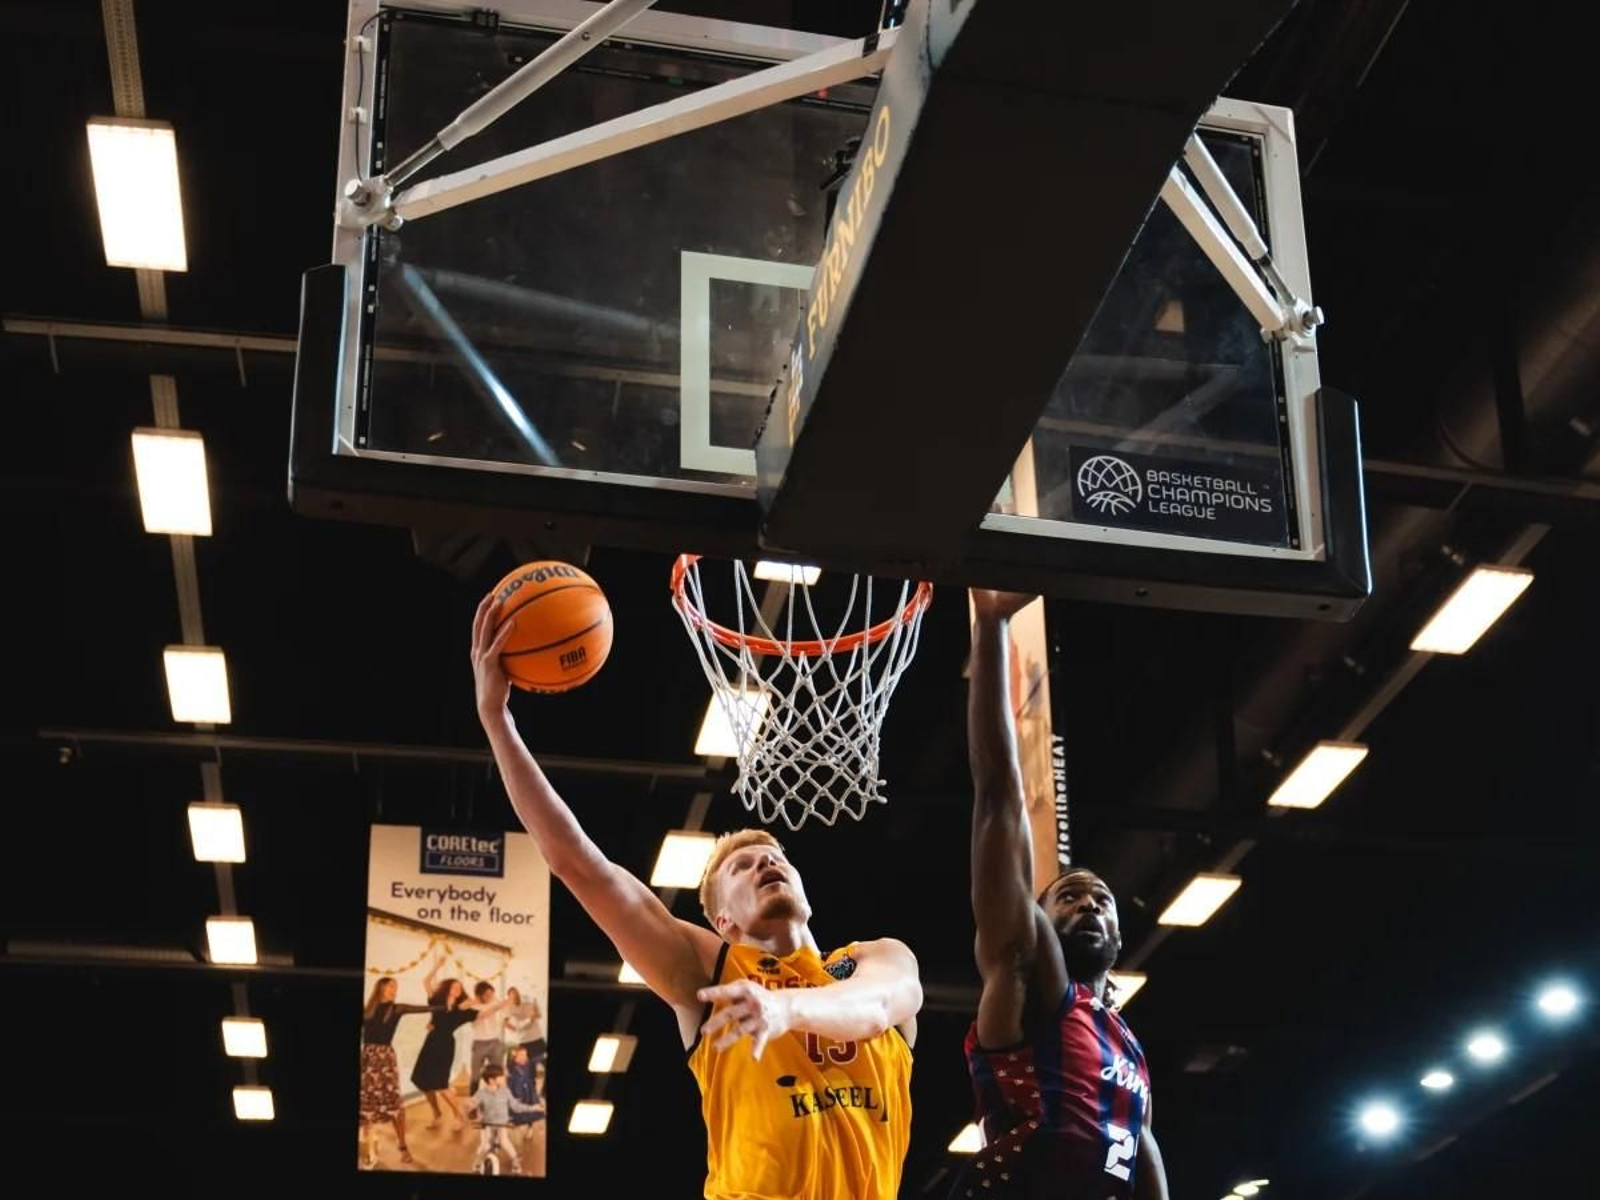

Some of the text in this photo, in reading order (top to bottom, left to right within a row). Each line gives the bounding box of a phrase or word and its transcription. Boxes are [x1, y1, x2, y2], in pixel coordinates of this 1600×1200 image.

[807, 105, 890, 361] FURNIBO
[1146, 469, 1258, 495] BASKETBALL
[1147, 484, 1273, 513] CHAMPIONS
[1148, 500, 1217, 520] LEAGUE
[559, 645, 587, 667] FIBA
[426, 834, 499, 854] COREtec
[440, 855, 485, 868] FLOORS
[391, 881, 497, 906] Everybody
[417, 905, 534, 925] on the floor
[1104, 1123, 1135, 1182] 2
